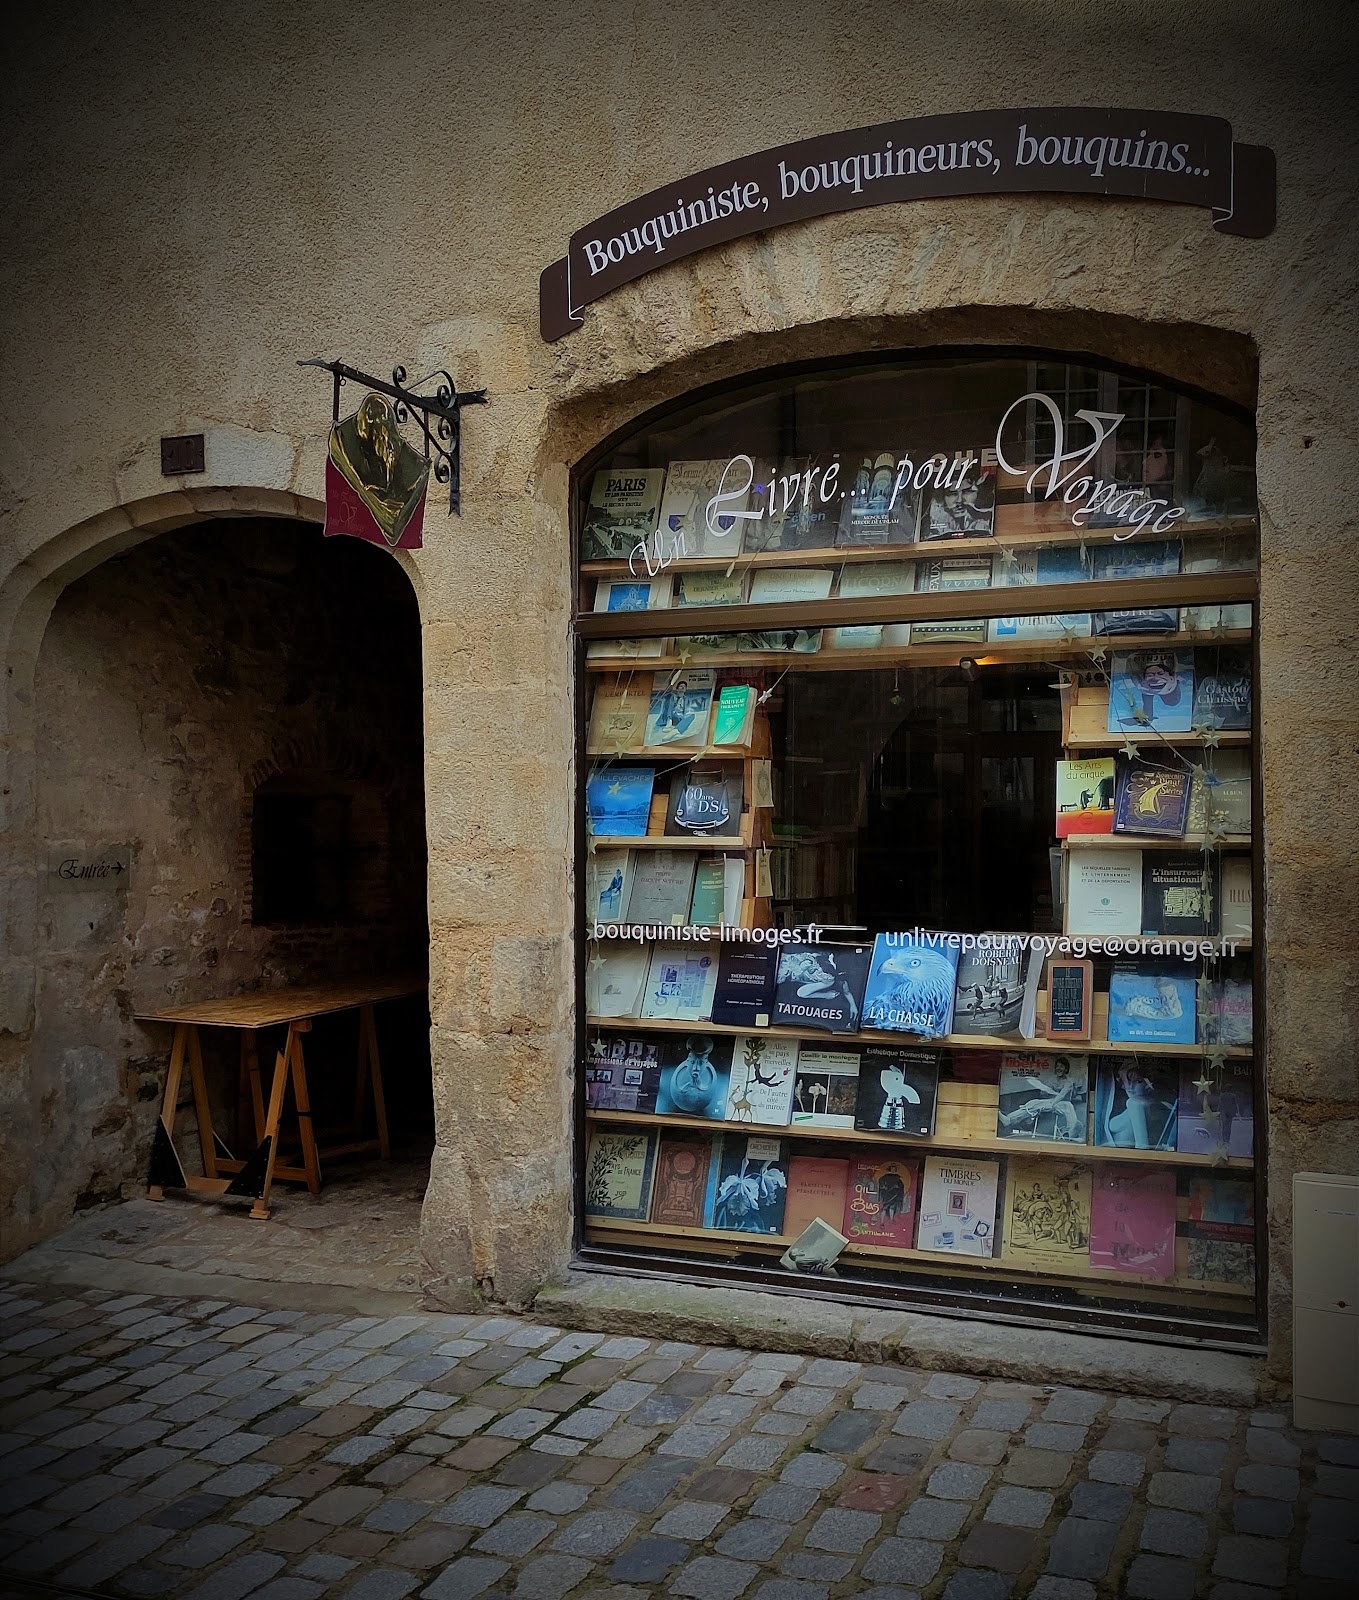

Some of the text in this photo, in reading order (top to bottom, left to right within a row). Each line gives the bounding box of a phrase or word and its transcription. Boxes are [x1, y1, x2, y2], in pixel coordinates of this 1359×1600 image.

[582, 124, 1210, 276] Bouquiniste, bouquineurs, bouquins...
[888, 453, 979, 512] pour
[995, 392, 1186, 542] Voyage
[605, 478, 647, 492] PARIS
[1069, 762, 1102, 770] Les Arts
[1066, 770, 1105, 781] du cirque
[686, 788, 702, 800] 60
[698, 801, 719, 813] DS
[58, 859, 111, 879] Entrée
[593, 918, 824, 948] bouquiniste-limoges.fr
[885, 926, 1240, 963] unlivrepourvoyage@orange.fr
[777, 1002, 843, 1020] TATOUAGES
[869, 1007, 935, 1027] LA CHASSE
[775, 1050, 790, 1058] pays
[866, 1047, 937, 1060] Esthétique Domestique
[767, 1088, 788, 1098] l'autre
[766, 1103, 786, 1111] miroir
[939, 1168, 982, 1181] TIMBRES
[953, 1179, 976, 1187] MONDE
